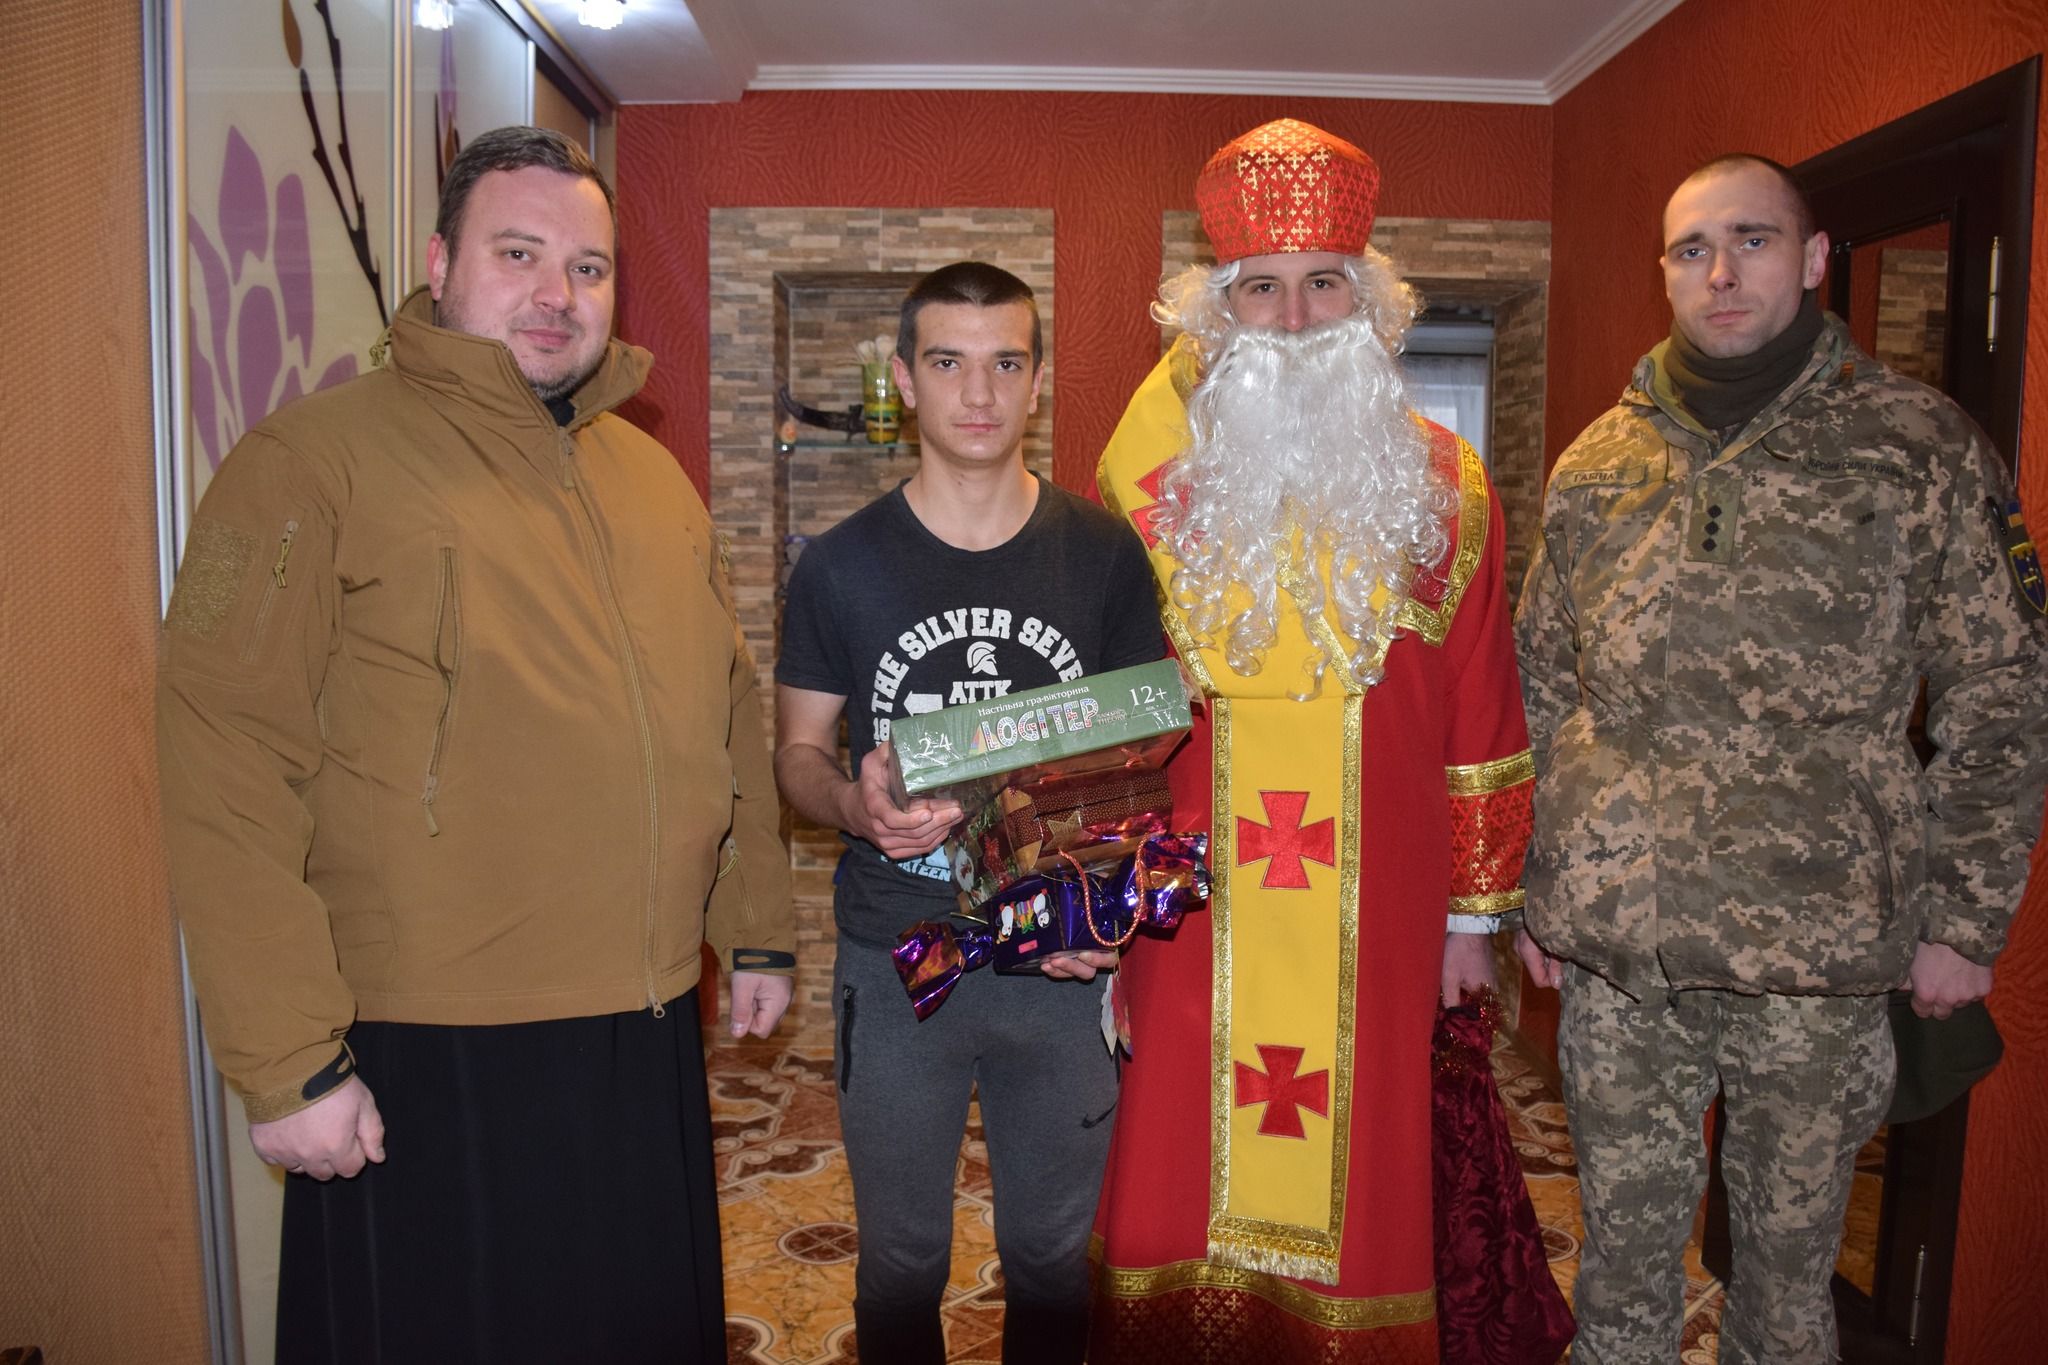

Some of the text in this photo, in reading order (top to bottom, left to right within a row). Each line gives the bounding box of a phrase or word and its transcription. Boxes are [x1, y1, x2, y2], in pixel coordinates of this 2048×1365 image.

[871, 607, 1084, 713] THE SILVER SEVE
[949, 679, 1012, 705] ATTK
[977, 686, 1090, 718] Настільна гра-вікторина
[1129, 685, 1168, 706] 12+
